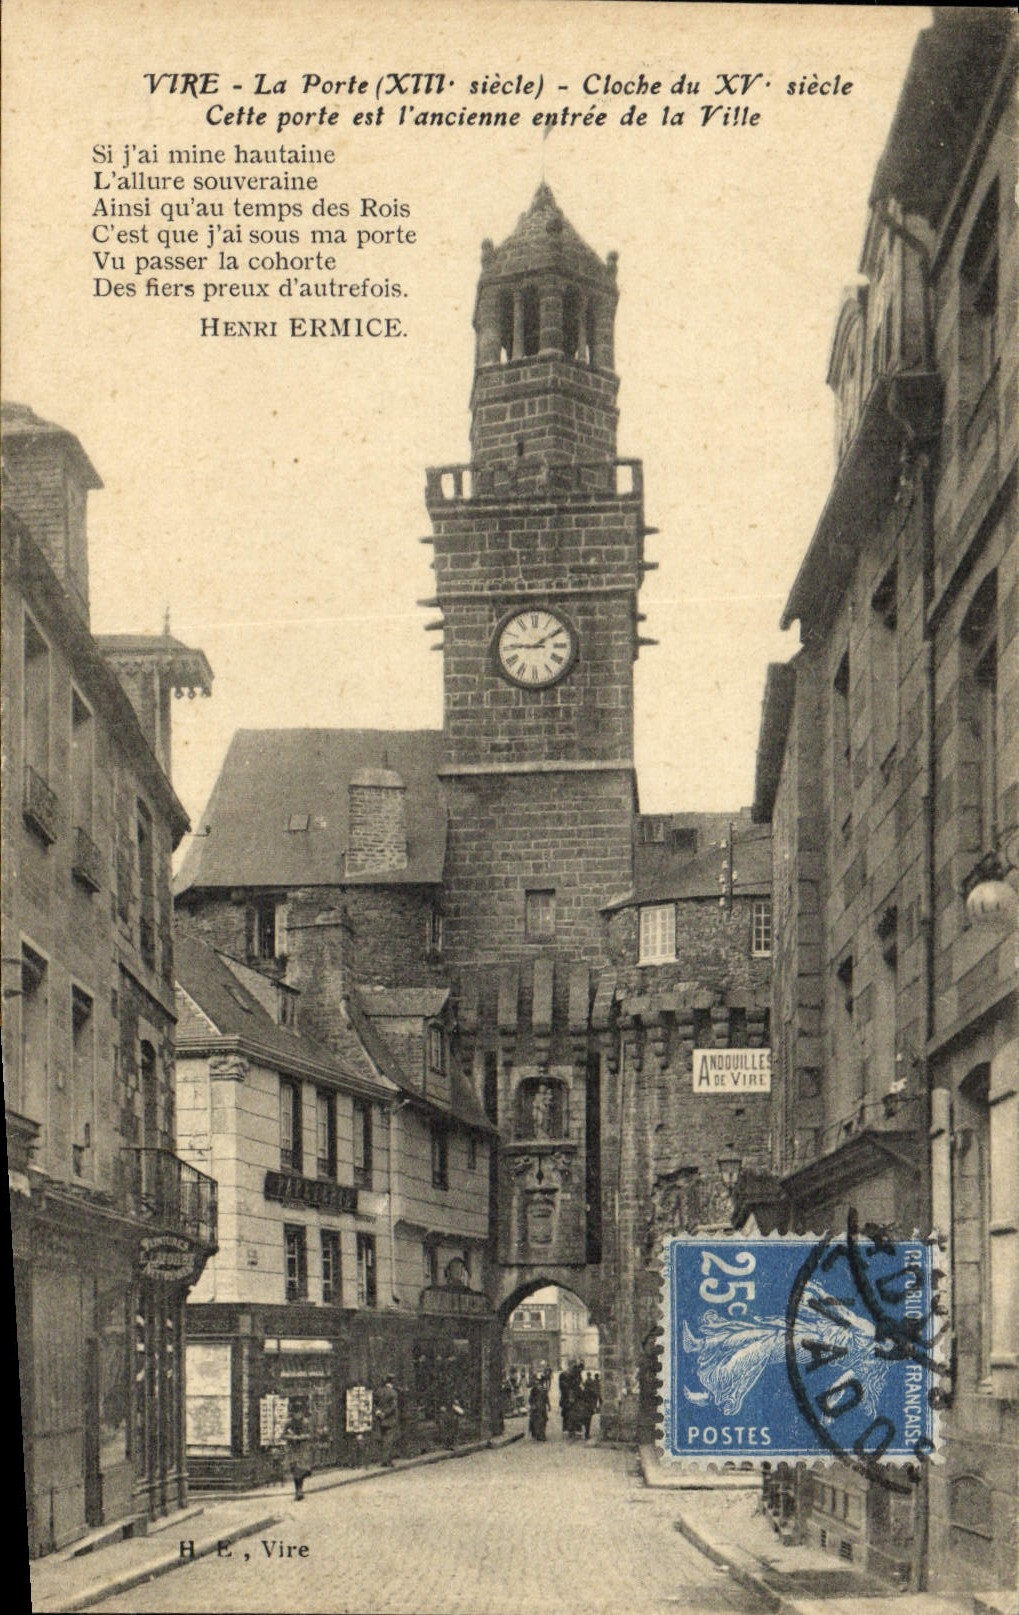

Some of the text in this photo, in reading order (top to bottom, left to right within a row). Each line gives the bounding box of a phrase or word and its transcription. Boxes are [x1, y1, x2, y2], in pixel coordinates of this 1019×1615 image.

[698, 1054, 772, 1087] ANDOUILLES
[714, 1072, 767, 1086] DE VIRE
[687, 1425, 772, 1446] POSTES
